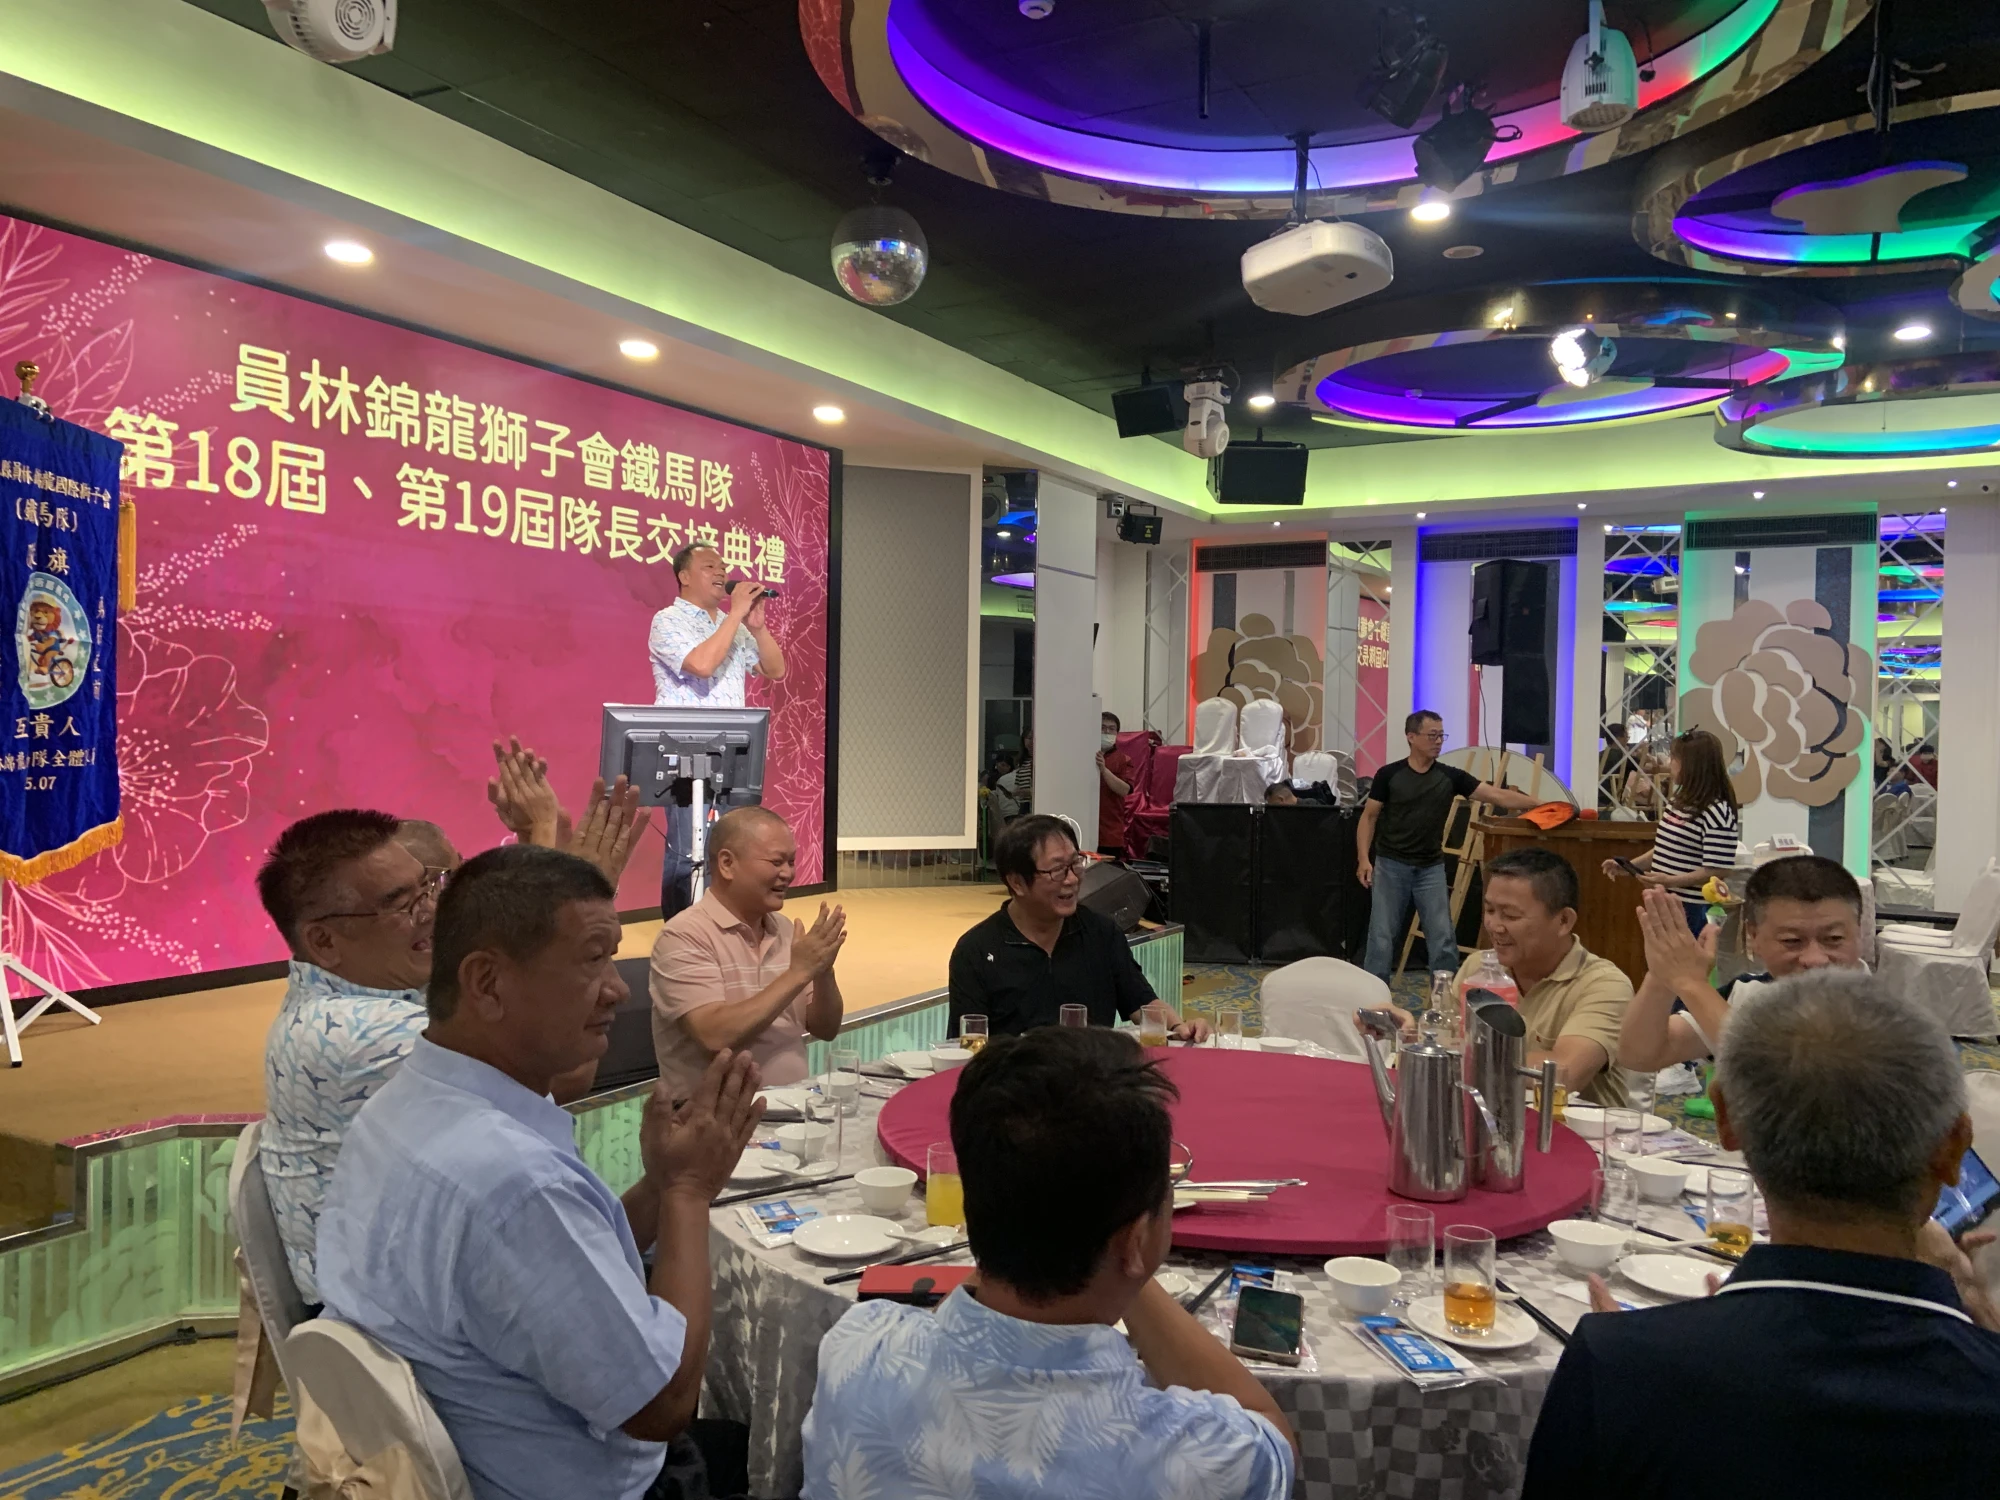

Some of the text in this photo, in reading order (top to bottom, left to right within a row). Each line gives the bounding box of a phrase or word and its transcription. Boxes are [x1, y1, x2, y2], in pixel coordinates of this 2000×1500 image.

[230, 343, 734, 512] 員林錦龍獅子會鐵馬隊
